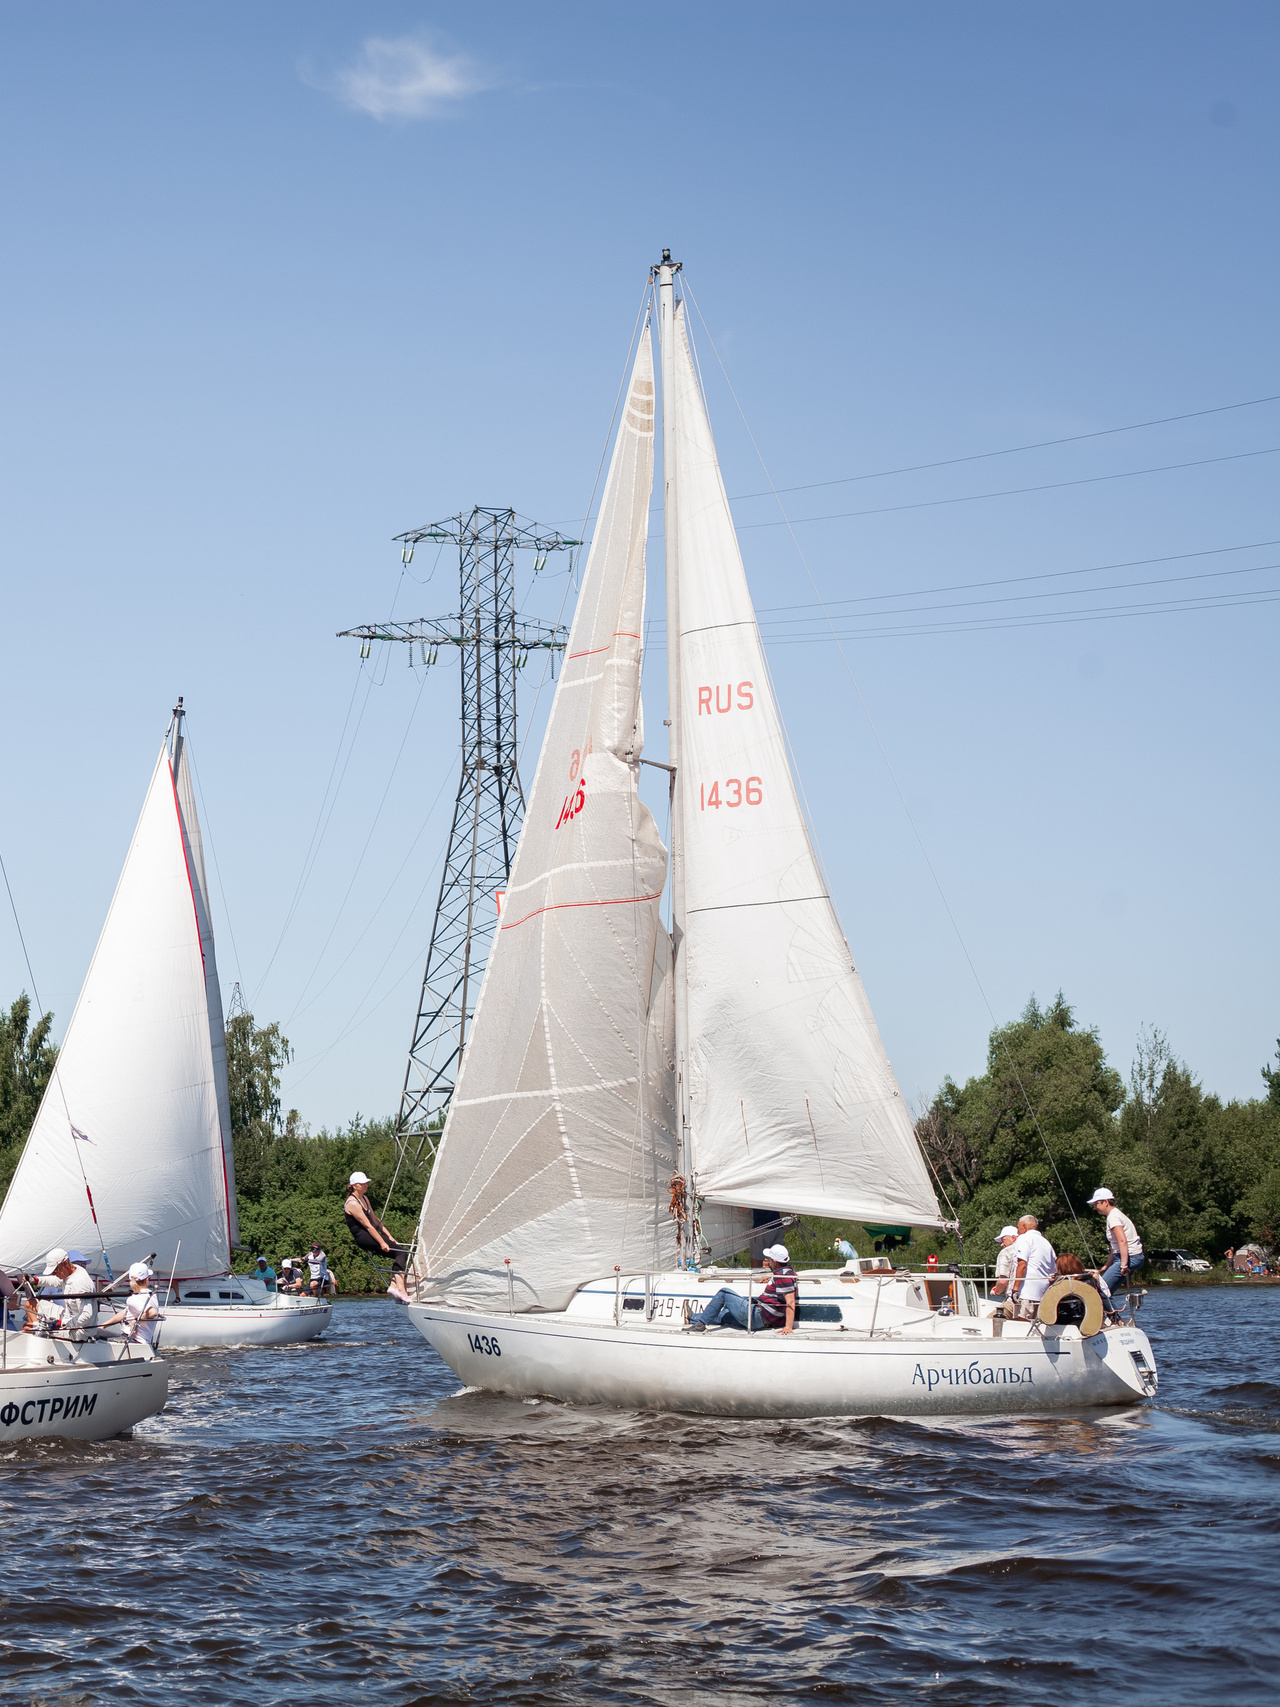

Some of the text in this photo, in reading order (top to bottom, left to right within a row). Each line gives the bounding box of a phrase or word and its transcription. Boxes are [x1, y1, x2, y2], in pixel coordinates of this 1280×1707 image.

[698, 681, 754, 715] RUS
[700, 776, 763, 811] 1436
[467, 1333, 501, 1357] 1436
[912, 1360, 1035, 1391] Арчибальд
